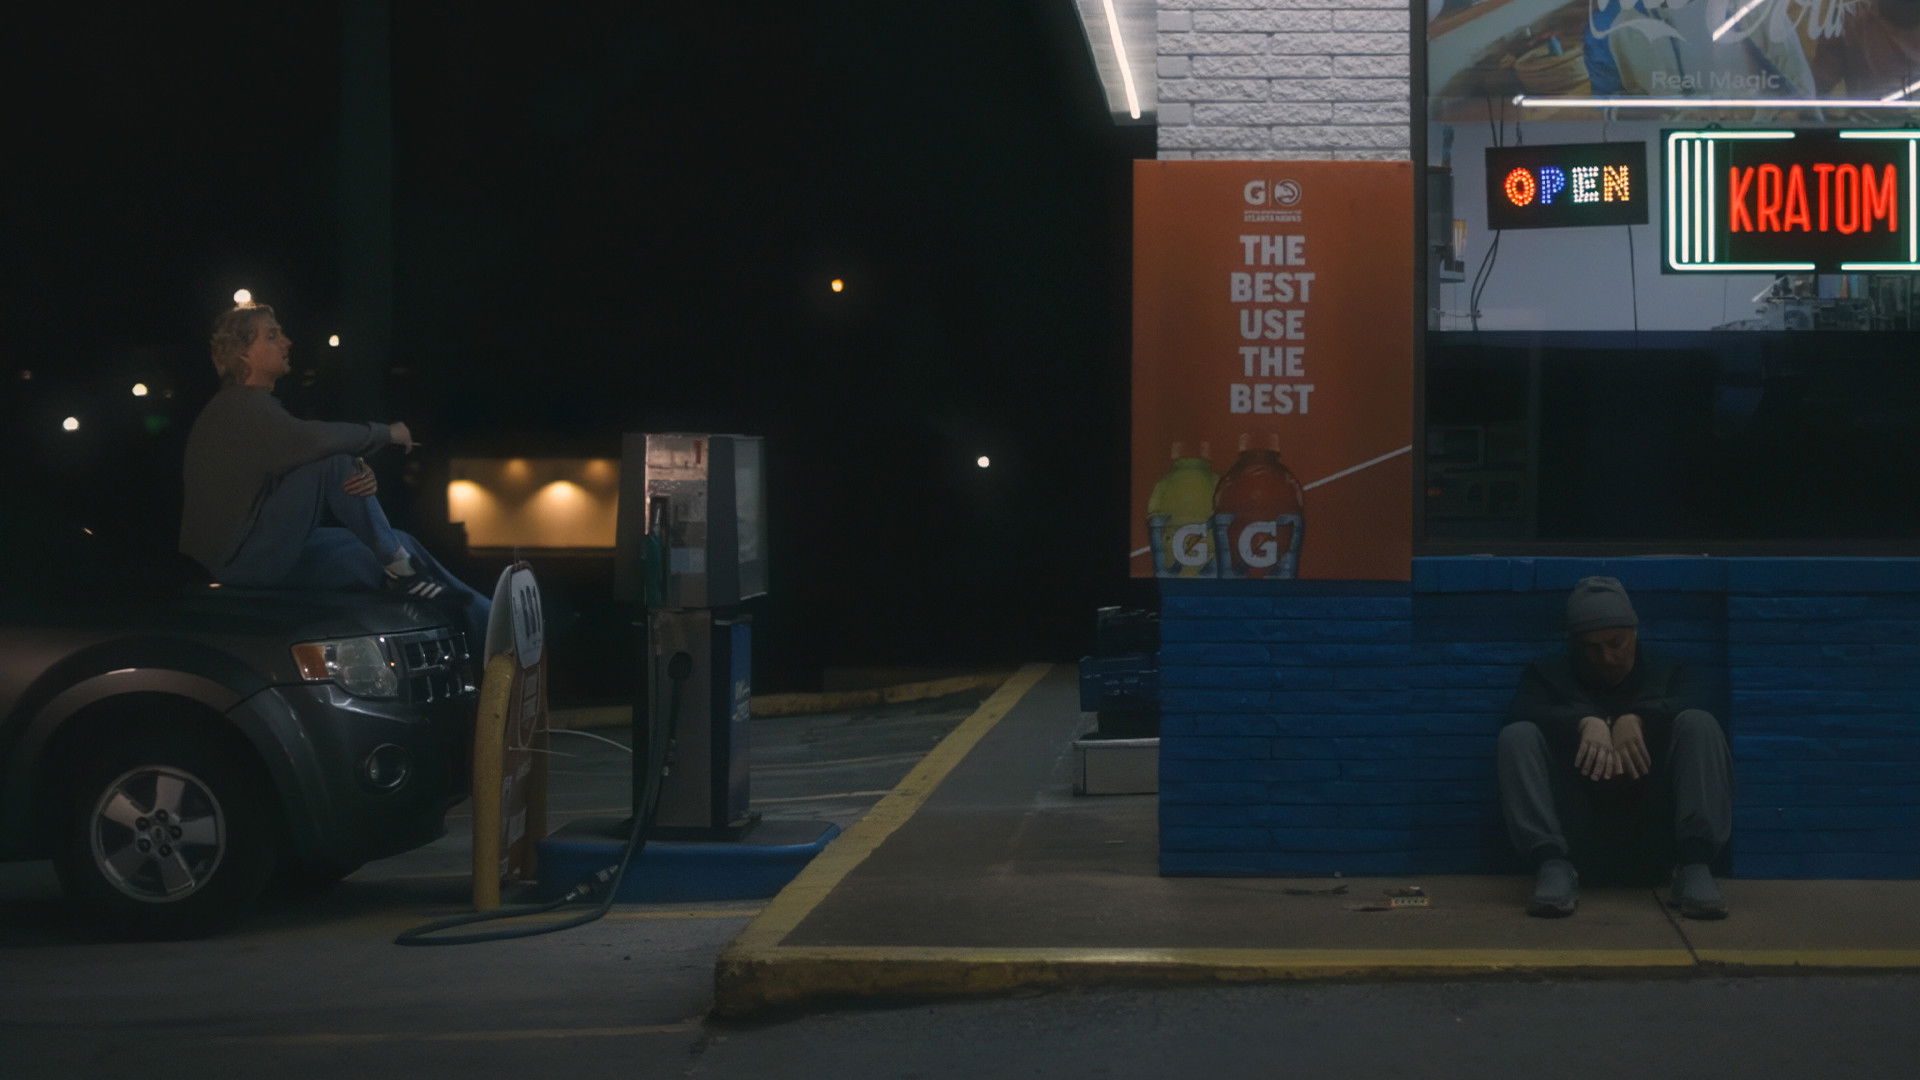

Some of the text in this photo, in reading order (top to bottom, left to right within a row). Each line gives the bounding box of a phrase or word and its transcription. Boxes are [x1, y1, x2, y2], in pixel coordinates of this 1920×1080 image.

[1652, 70, 1780, 91] Real Magic
[1244, 181, 1266, 205] G
[1504, 165, 1630, 207] OPEN
[1730, 163, 1898, 235] KRATOM
[1239, 235, 1305, 265] THE
[1231, 272, 1316, 302] BEST
[1240, 309, 1305, 340] USE
[1239, 347, 1305, 377] THE
[1230, 383, 1315, 414] BEST
[1172, 523, 1208, 566] G
[1238, 521, 1278, 568] G
